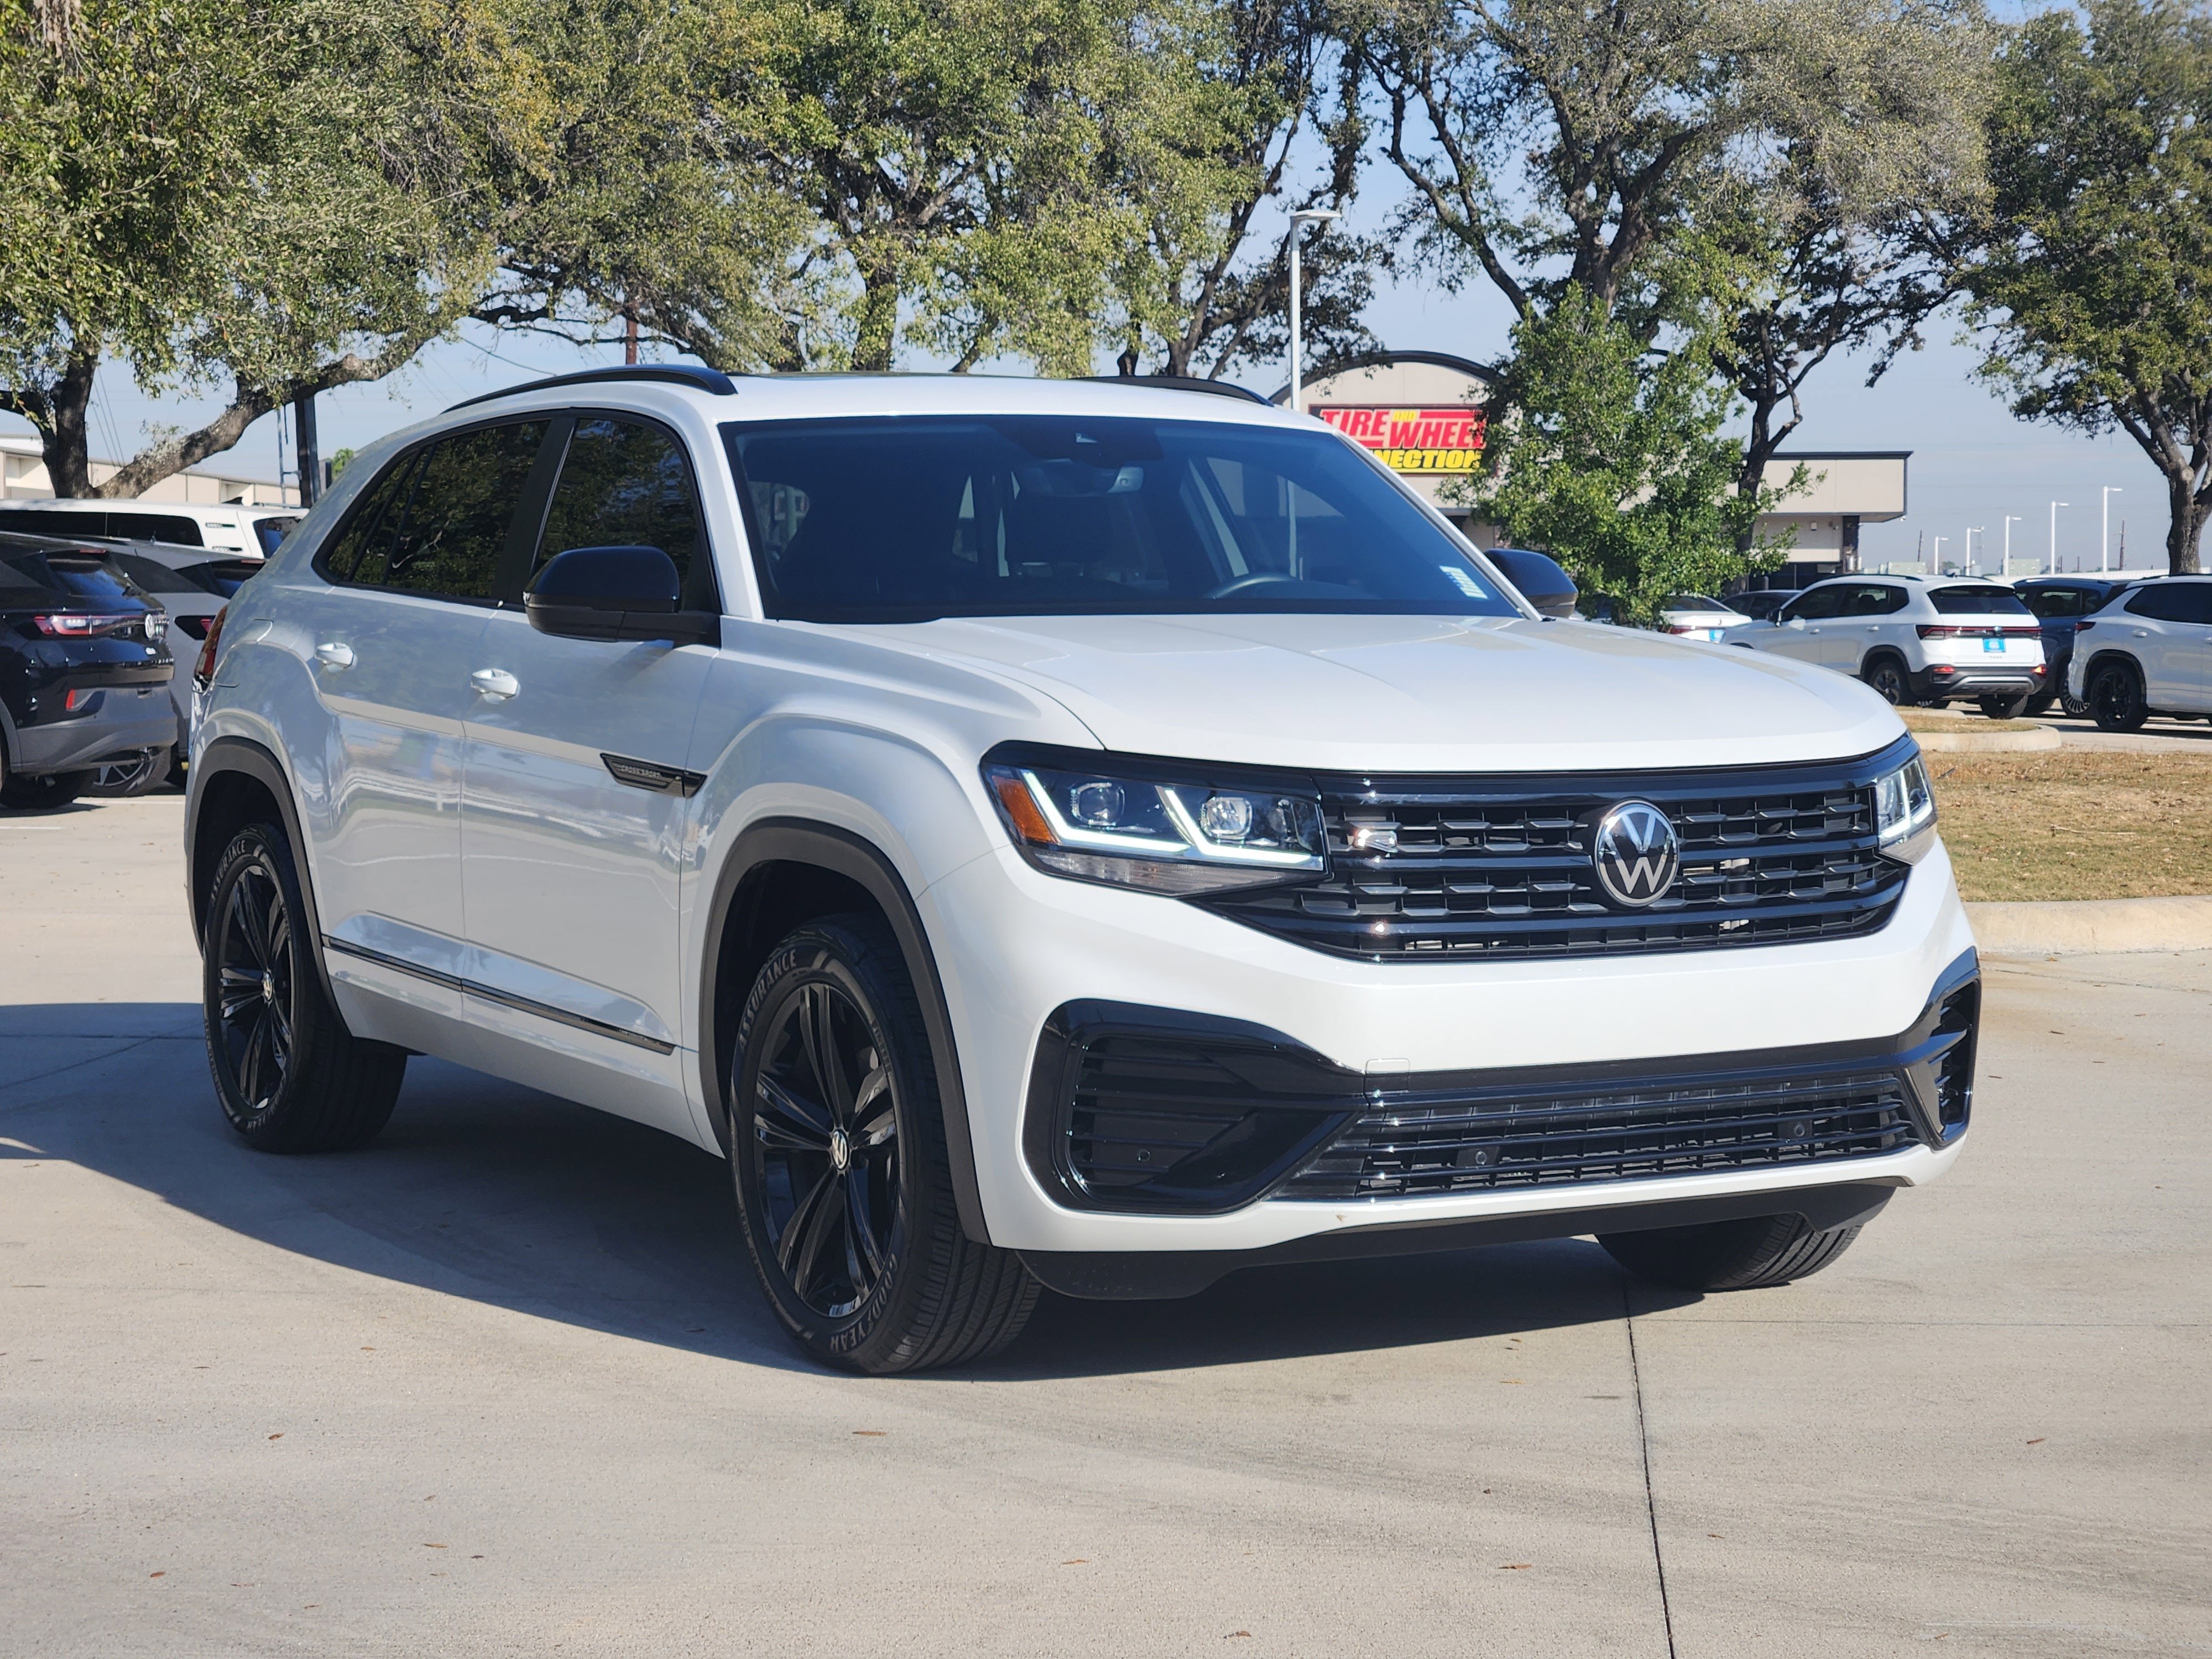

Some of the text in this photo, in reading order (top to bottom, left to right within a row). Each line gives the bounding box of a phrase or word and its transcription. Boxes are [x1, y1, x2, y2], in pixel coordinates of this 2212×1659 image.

[1321, 409, 1485, 450] TIRE AND WHEEL
[1369, 449, 1482, 468] NECTION
[621, 765, 661, 779] CROSS SPORT
[1595, 799, 1679, 907] VW
[738, 949, 797, 1053] ASSURANCE
[831, 1253, 898, 1353] GOODYEAR
